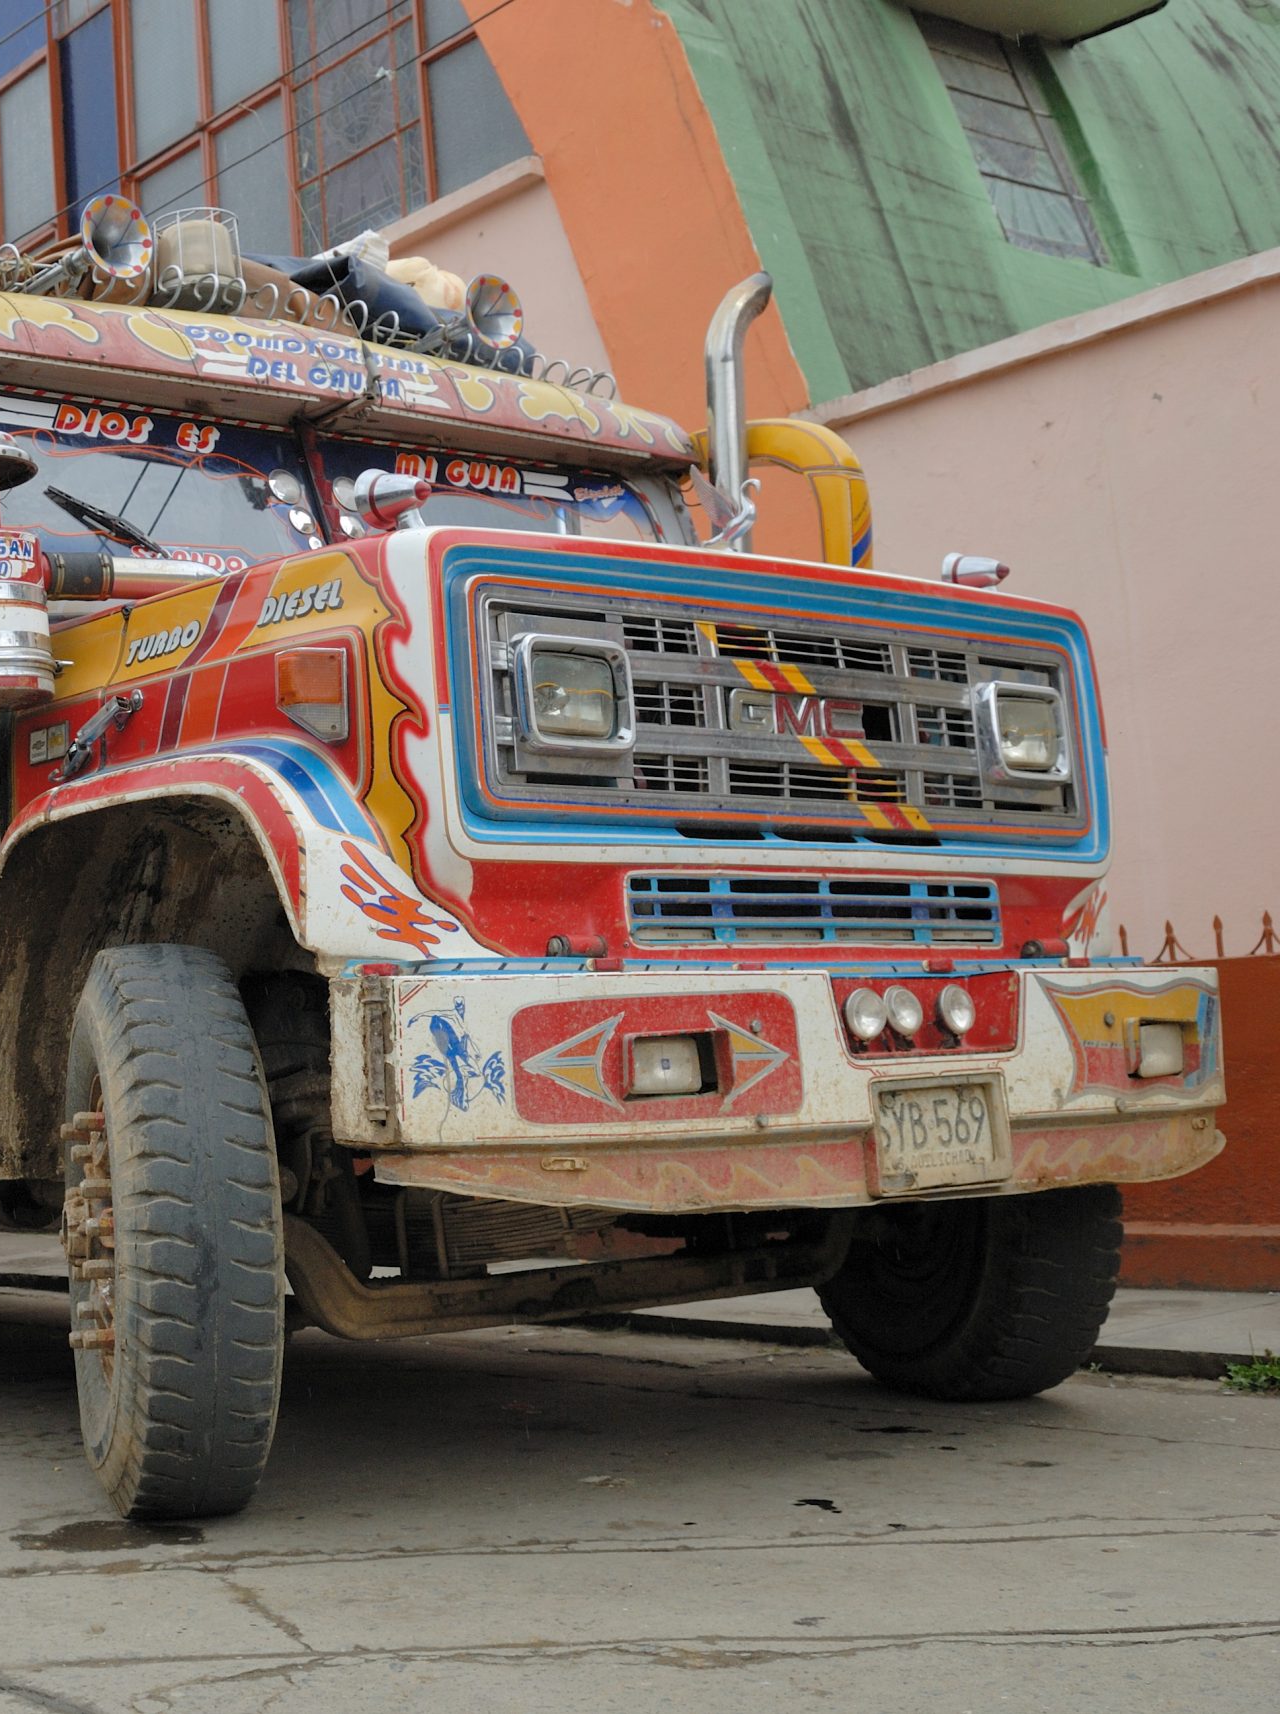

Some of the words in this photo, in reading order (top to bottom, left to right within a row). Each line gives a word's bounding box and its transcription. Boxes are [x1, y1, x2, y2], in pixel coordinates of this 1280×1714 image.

[184, 324, 430, 375] COOMOTORSTAS
[246, 355, 305, 386] DEL
[307, 366, 403, 399] CAUA
[54, 403, 154, 443] DIOS
[176, 422, 220, 454] ES
[395, 452, 438, 483] MI
[445, 459, 522, 495] GUIA
[256, 578, 344, 627] DIESEL
[125, 619, 202, 667] TURBO
[729, 687, 867, 740] GMC
[932, 1095, 986, 1148] 569
